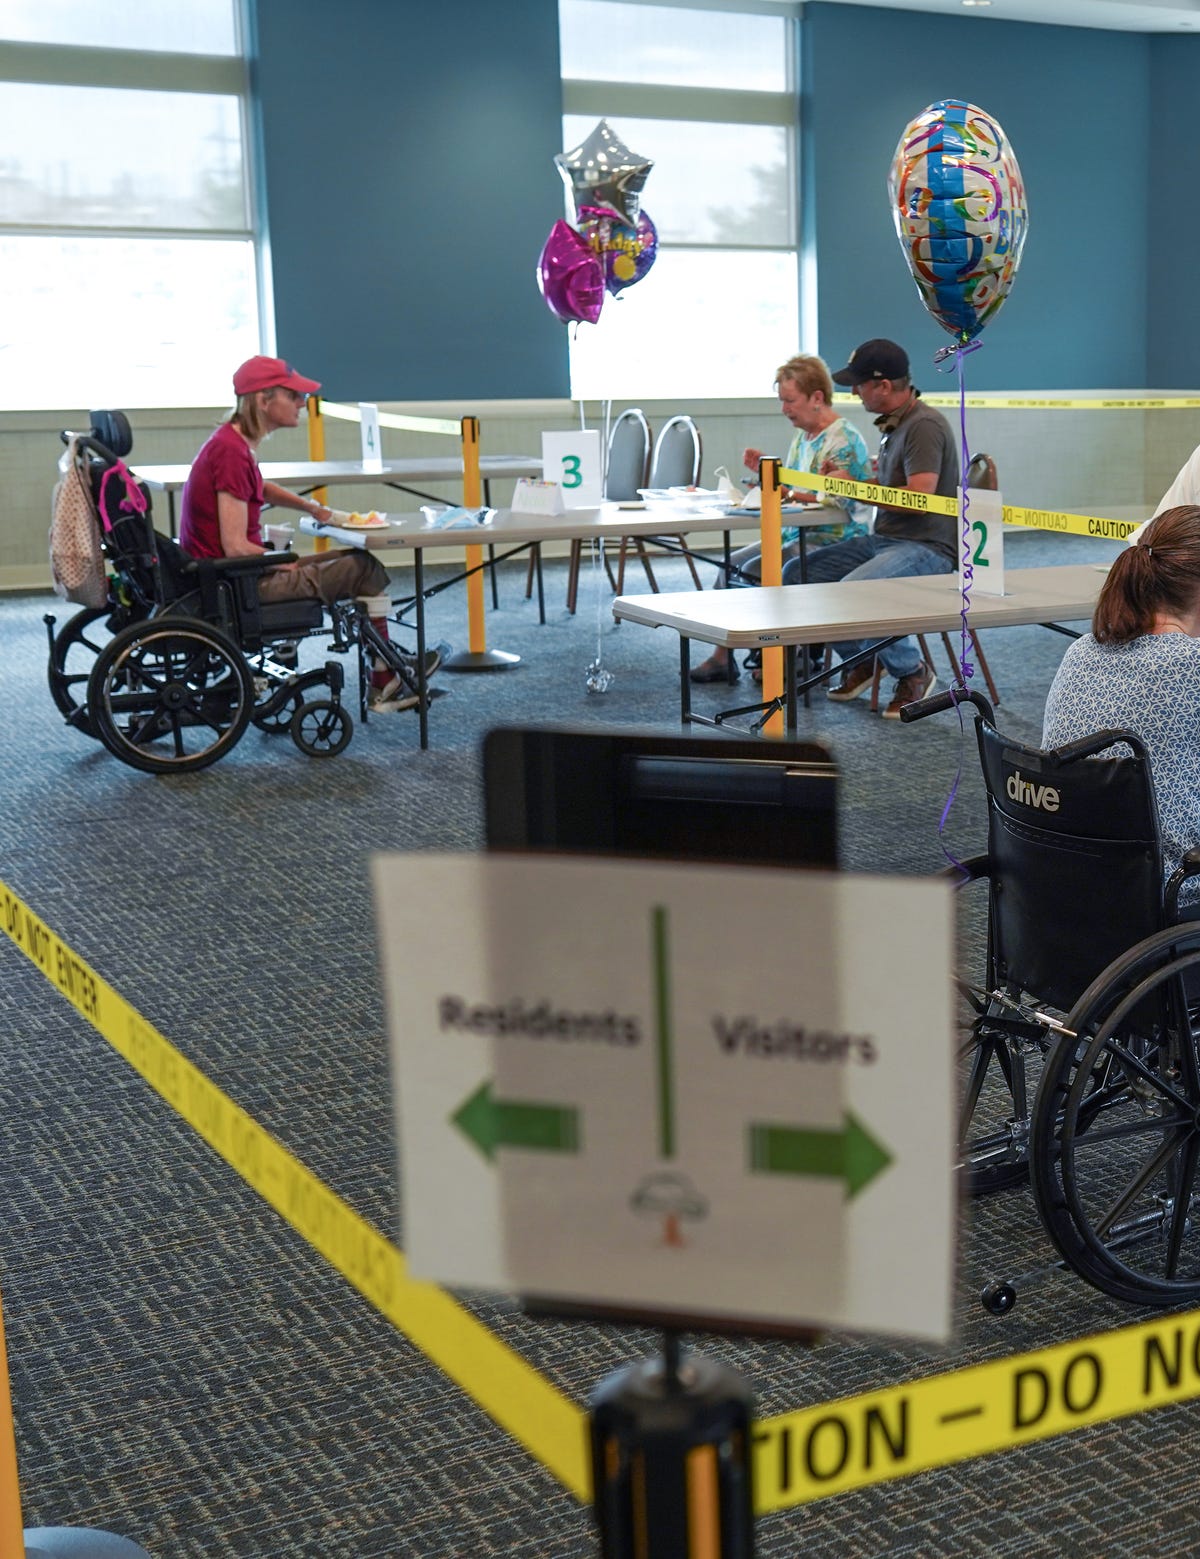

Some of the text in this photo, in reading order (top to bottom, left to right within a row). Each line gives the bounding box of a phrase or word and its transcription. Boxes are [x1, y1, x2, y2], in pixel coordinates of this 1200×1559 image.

[367, 425, 375, 452] 4
[561, 455, 583, 489] 3
[824, 478, 858, 497] CAUTION
[867, 487, 878, 500] DO
[882, 490, 899, 505] NOT
[902, 492, 928, 509] ENTER
[972, 520, 990, 567] 2
[1006, 770, 1060, 812] drive
[25, 914, 51, 973] NOT
[56, 943, 100, 1023] ENTER
[438, 993, 880, 1066] Residents Visitors
[1012, 1351, 1105, 1432] DO
